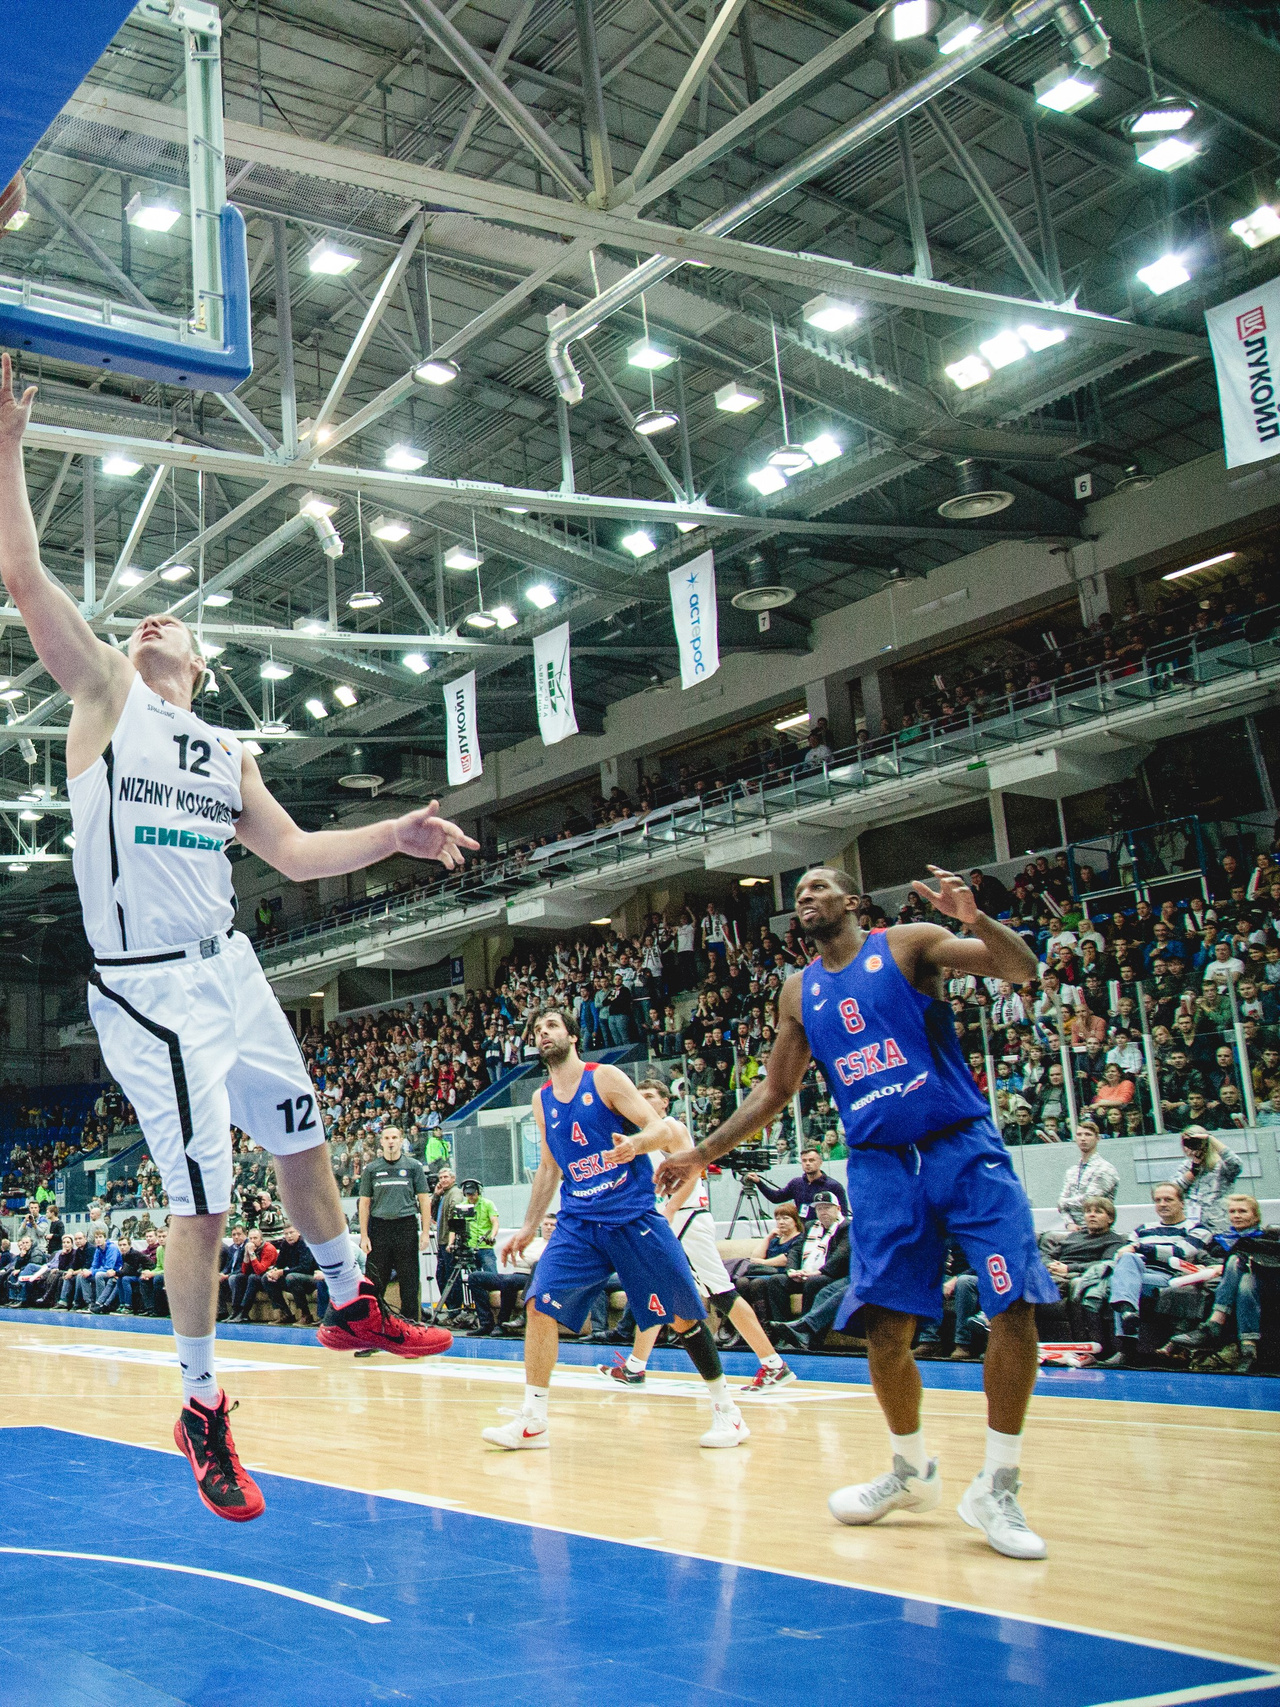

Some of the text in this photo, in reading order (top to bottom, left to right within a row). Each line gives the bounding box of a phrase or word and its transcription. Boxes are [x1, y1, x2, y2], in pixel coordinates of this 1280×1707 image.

[1243, 336, 1280, 443] ЛУКОЙЛ
[1079, 481, 1087, 493] 6
[689, 593, 705, 675] астерос
[454, 688, 470, 754] ЛУКОЙЛ
[173, 733, 212, 778] 12
[119, 776, 173, 808] NIZHNY
[839, 997, 866, 1034] 8
[834, 1037, 908, 1087] CSKA
[277, 1094, 317, 1133] 12
[851, 1082, 903, 1111] AEROFLOT
[572, 1121, 589, 1146] 4
[987, 1253, 1013, 1295] 8
[648, 1293, 666, 1317] 4
